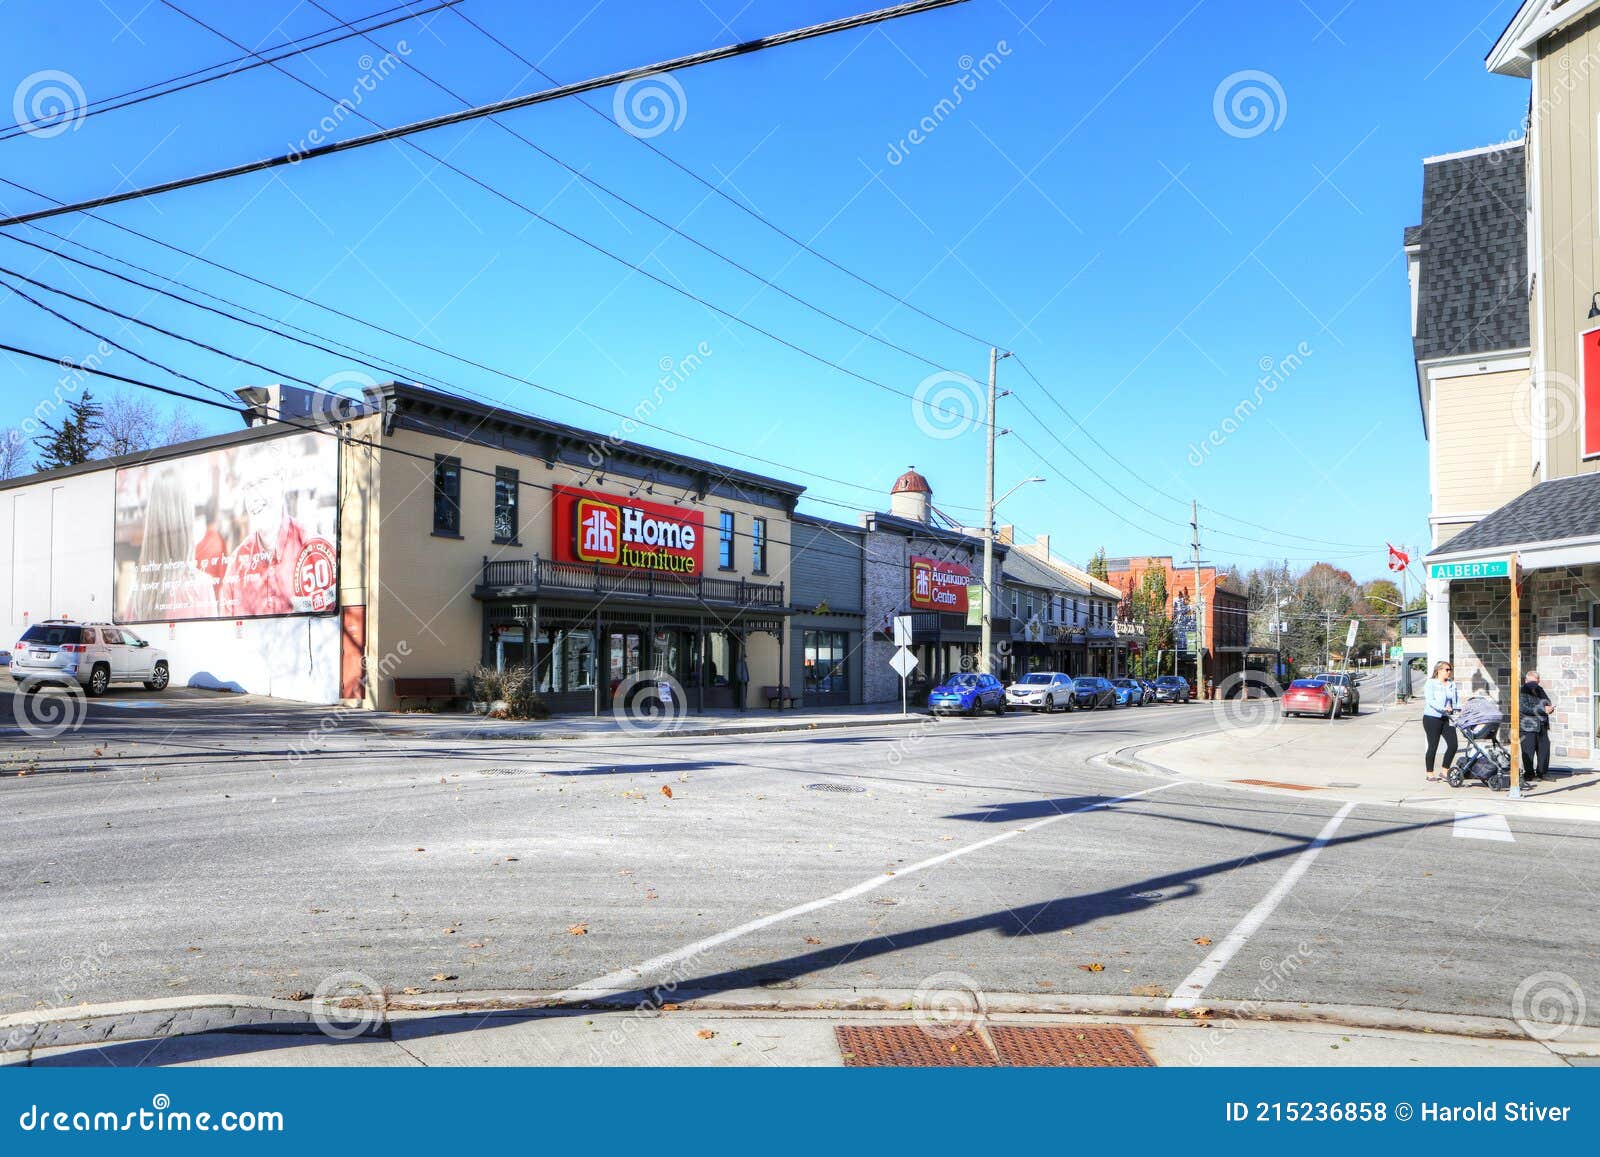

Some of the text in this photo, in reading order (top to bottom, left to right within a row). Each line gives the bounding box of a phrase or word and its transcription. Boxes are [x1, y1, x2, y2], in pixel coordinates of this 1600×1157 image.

[622, 507, 696, 550] Home
[622, 543, 695, 574] furniture
[1437, 563, 1489, 578] ALBERT
[302, 559, 328, 592] 50
[932, 567, 970, 587] Appliance
[932, 588, 957, 605] Centre
